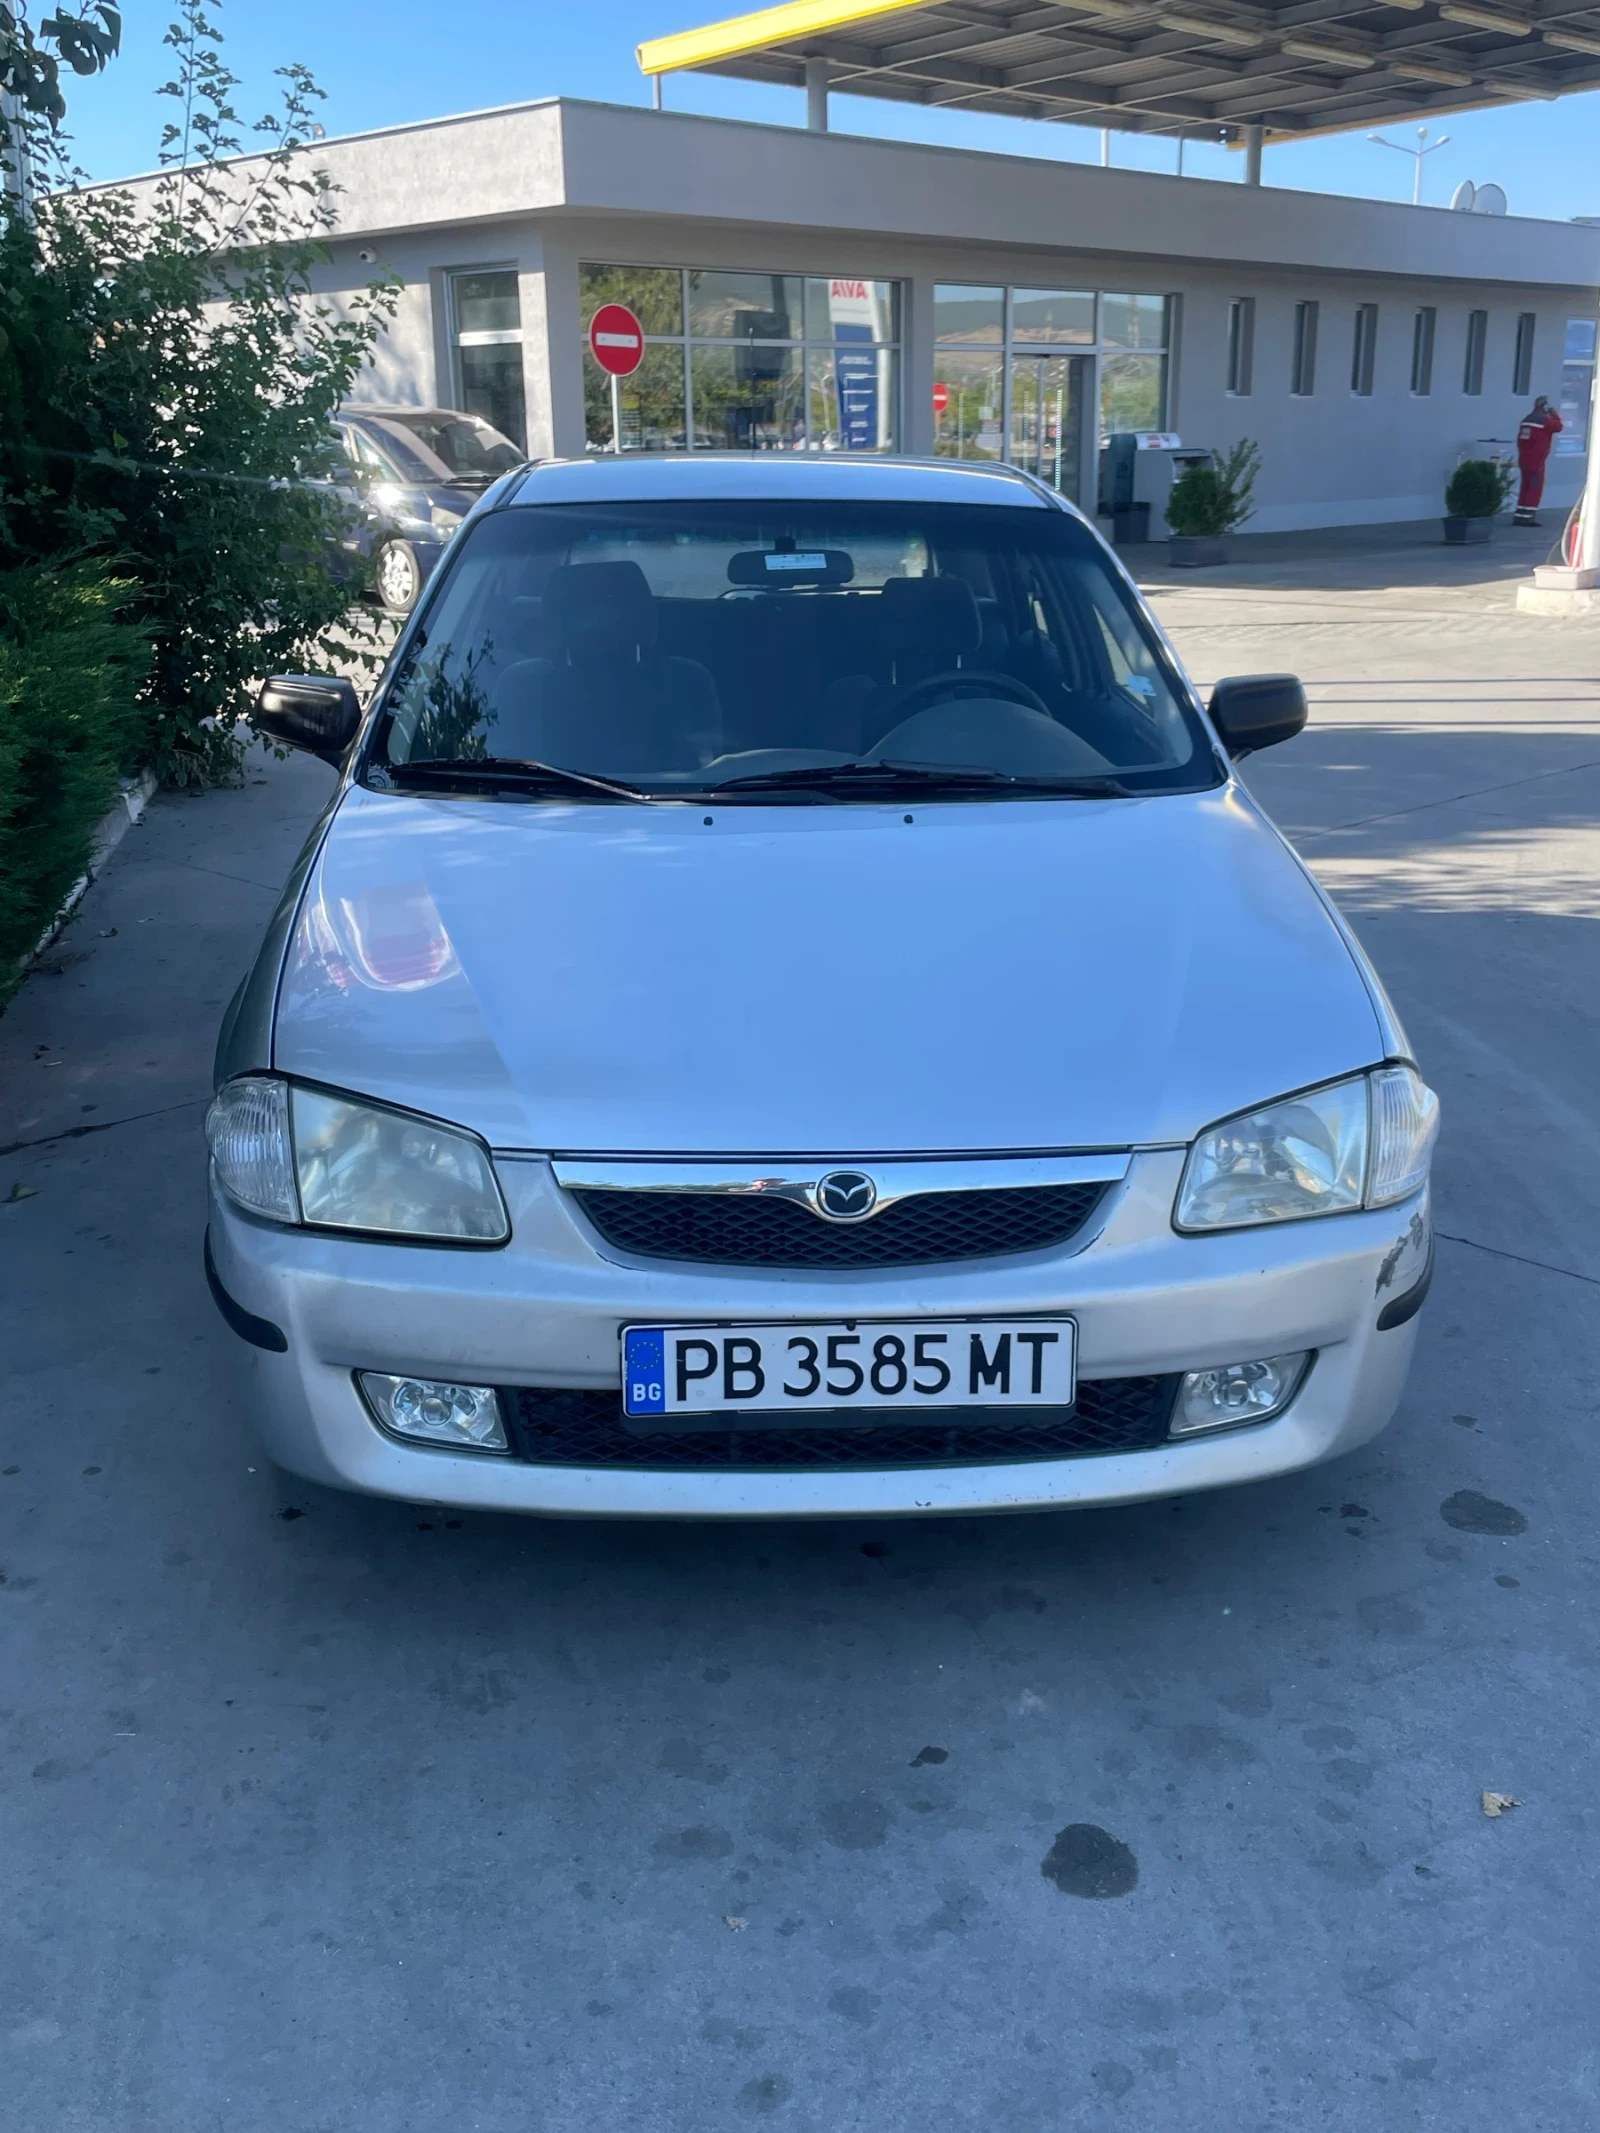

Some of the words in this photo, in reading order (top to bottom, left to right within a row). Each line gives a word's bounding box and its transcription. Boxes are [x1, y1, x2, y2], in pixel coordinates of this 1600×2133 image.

[675, 1337, 766, 1401] PB
[783, 1333, 951, 1397] 3585
[969, 1332, 1059, 1394] MT
[632, 1382, 662, 1402] BG
